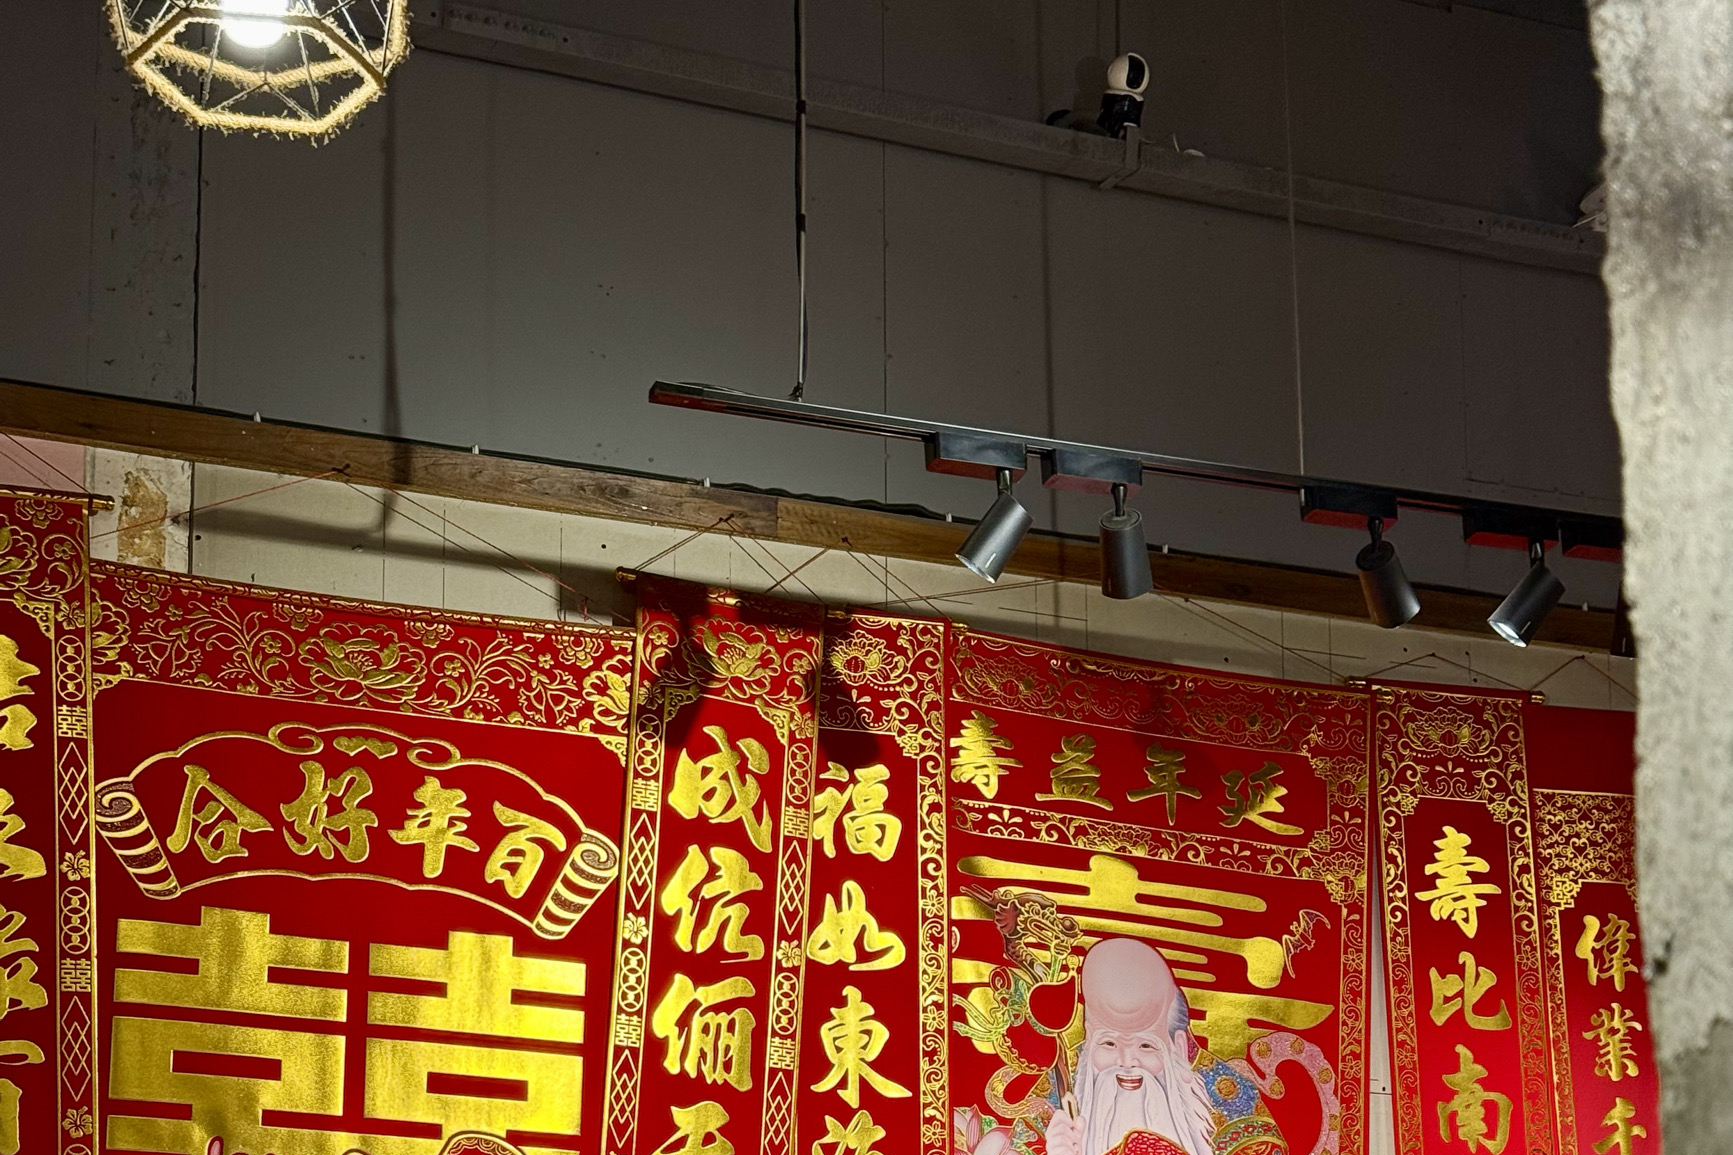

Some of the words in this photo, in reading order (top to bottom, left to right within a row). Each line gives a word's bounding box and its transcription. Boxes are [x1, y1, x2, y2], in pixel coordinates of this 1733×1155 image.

[166, 760, 567, 899] 百年好合
[950, 710, 1304, 836] 延年益壽
